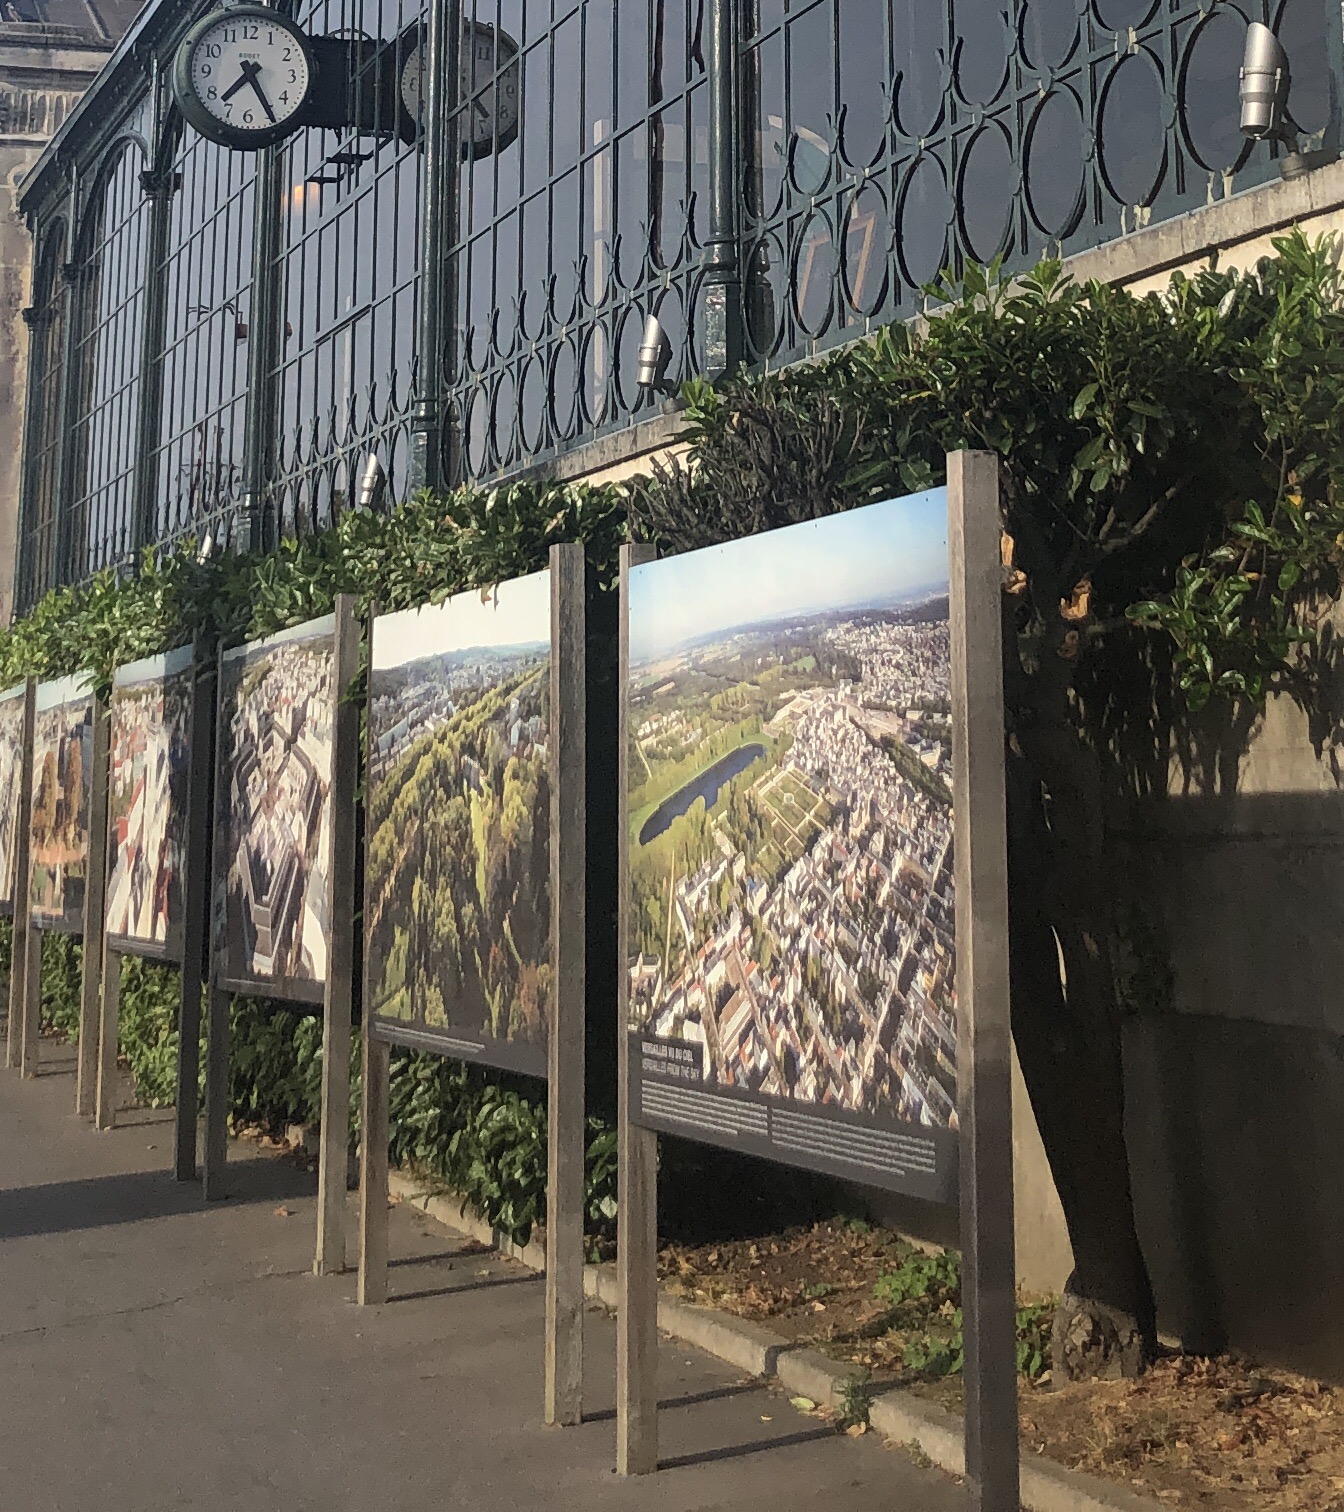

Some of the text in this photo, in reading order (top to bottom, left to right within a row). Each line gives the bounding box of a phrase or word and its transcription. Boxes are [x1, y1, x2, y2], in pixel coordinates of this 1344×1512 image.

[223, 29, 237, 43] 11
[243, 26, 259, 40] 12
[267, 31, 274, 45] 1
[205, 43, 222, 58] 10
[282, 48, 291, 62] 2
[201, 64, 212, 78] 9
[287, 69, 297, 84] 3
[207, 86, 218, 101] 8
[278, 90, 289, 105] 4
[224, 103, 233, 118] 7
[242, 109, 254, 123] 6
